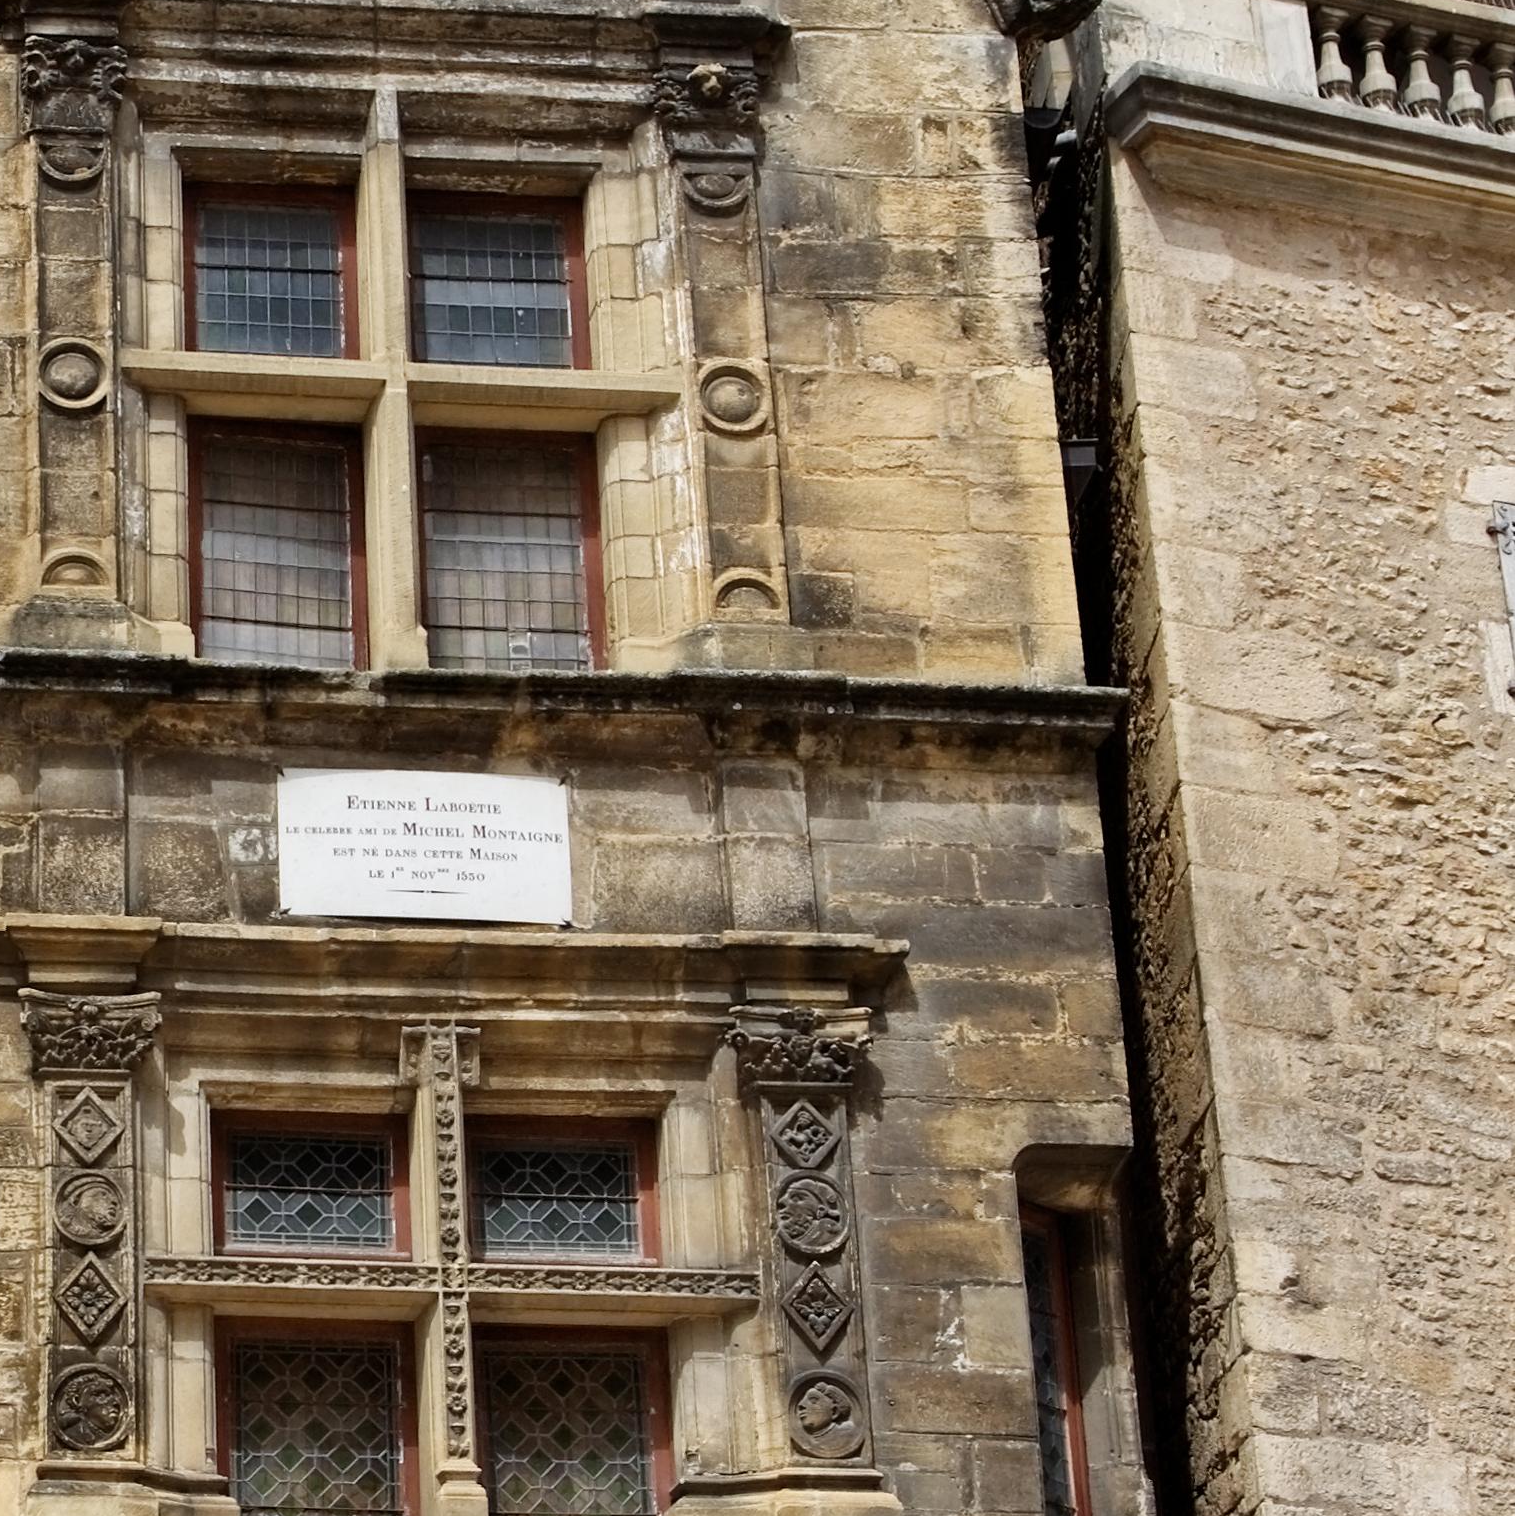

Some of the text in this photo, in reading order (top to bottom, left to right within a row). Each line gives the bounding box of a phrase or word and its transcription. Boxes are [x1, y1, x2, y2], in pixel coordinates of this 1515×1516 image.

[347, 795, 417, 811] ETIENNE
[286, 826, 300, 834] LE
[357, 827, 377, 835] AMI
[383, 828, 398, 836] DE
[403, 822, 465, 838] MICHEL
[472, 825, 564, 844] MONTAIGNE
[333, 847, 356, 857] EST
[385, 848, 418, 858] DANS
[424, 849, 464, 860] CETTE
[470, 848, 518, 862] MAISON
[369, 869, 384, 879] LE
